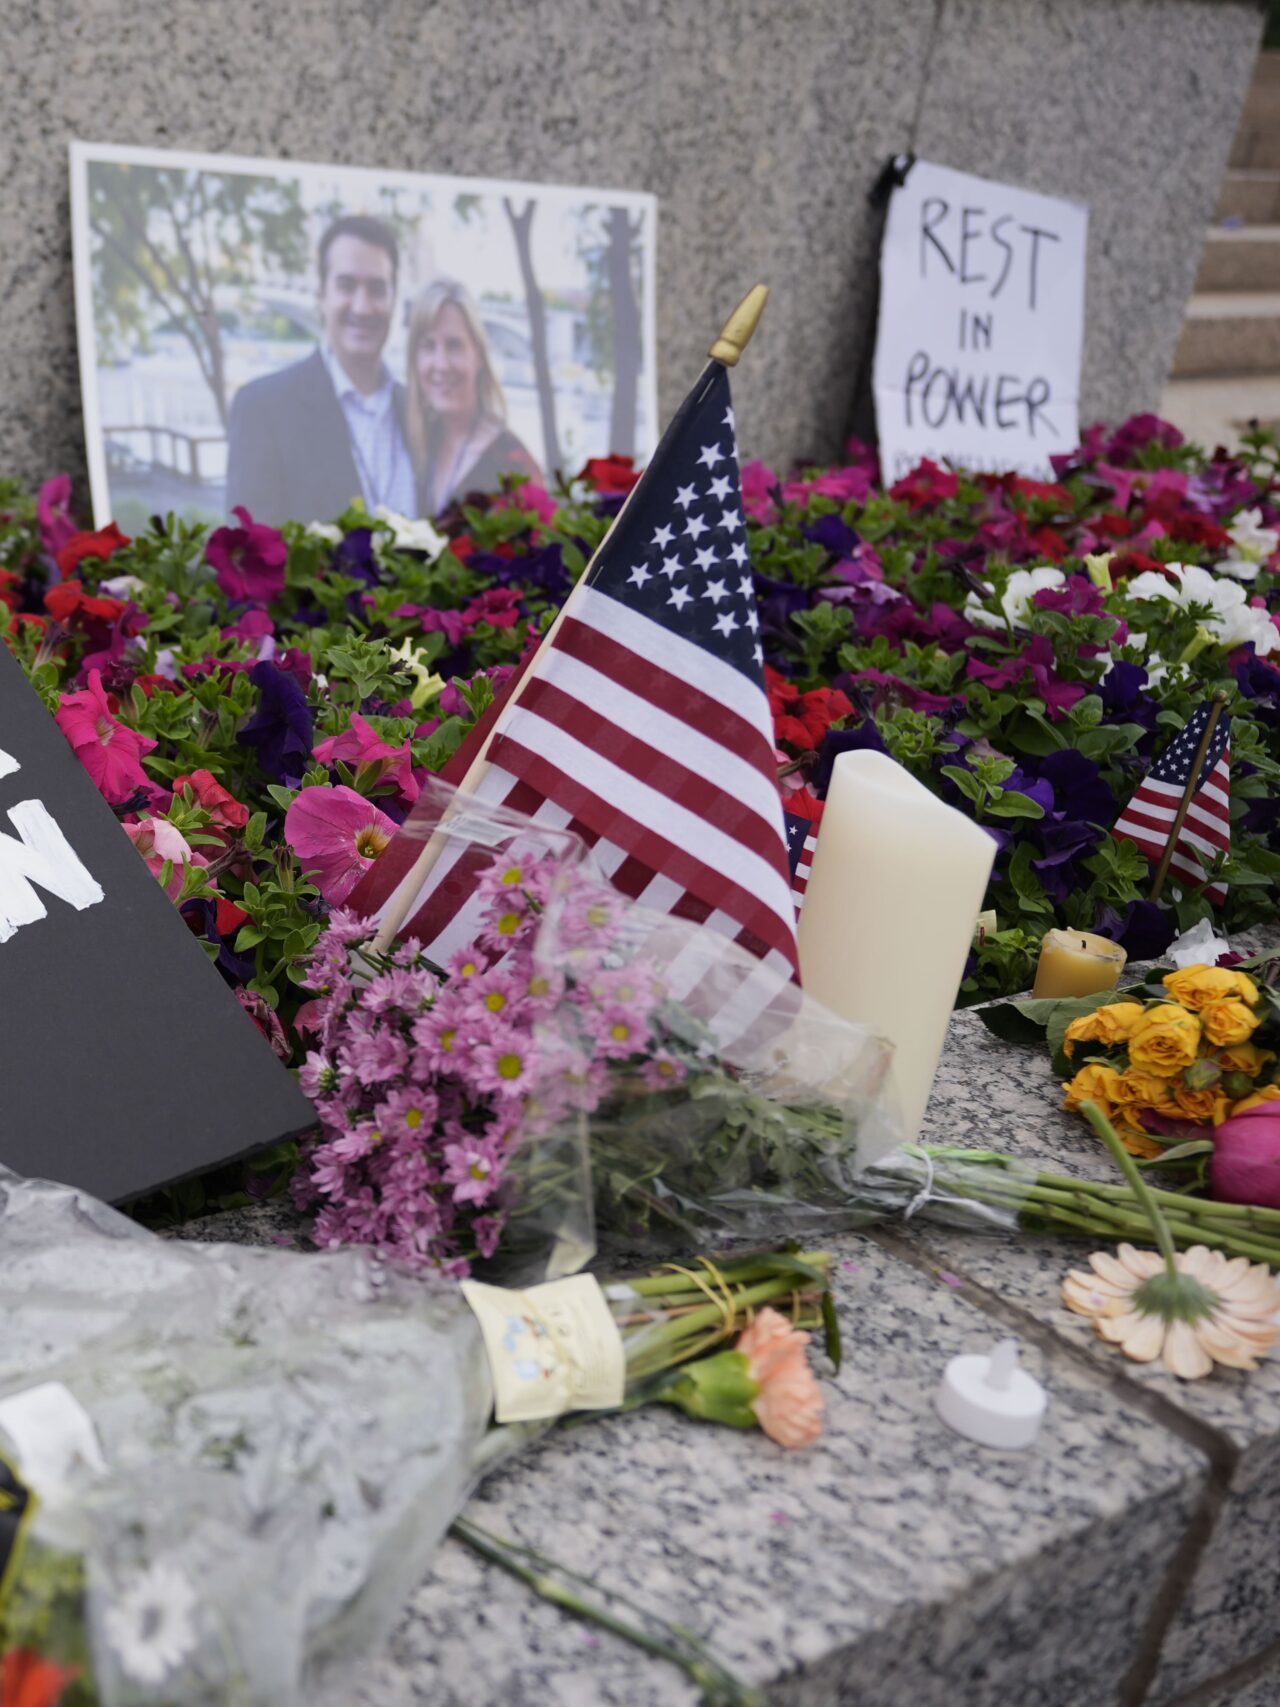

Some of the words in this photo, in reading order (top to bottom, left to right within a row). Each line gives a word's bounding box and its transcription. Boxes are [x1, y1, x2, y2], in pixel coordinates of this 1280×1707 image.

[921, 197, 1062, 312] REST
[958, 308, 993, 351] IN
[905, 350, 1060, 438] POWER
